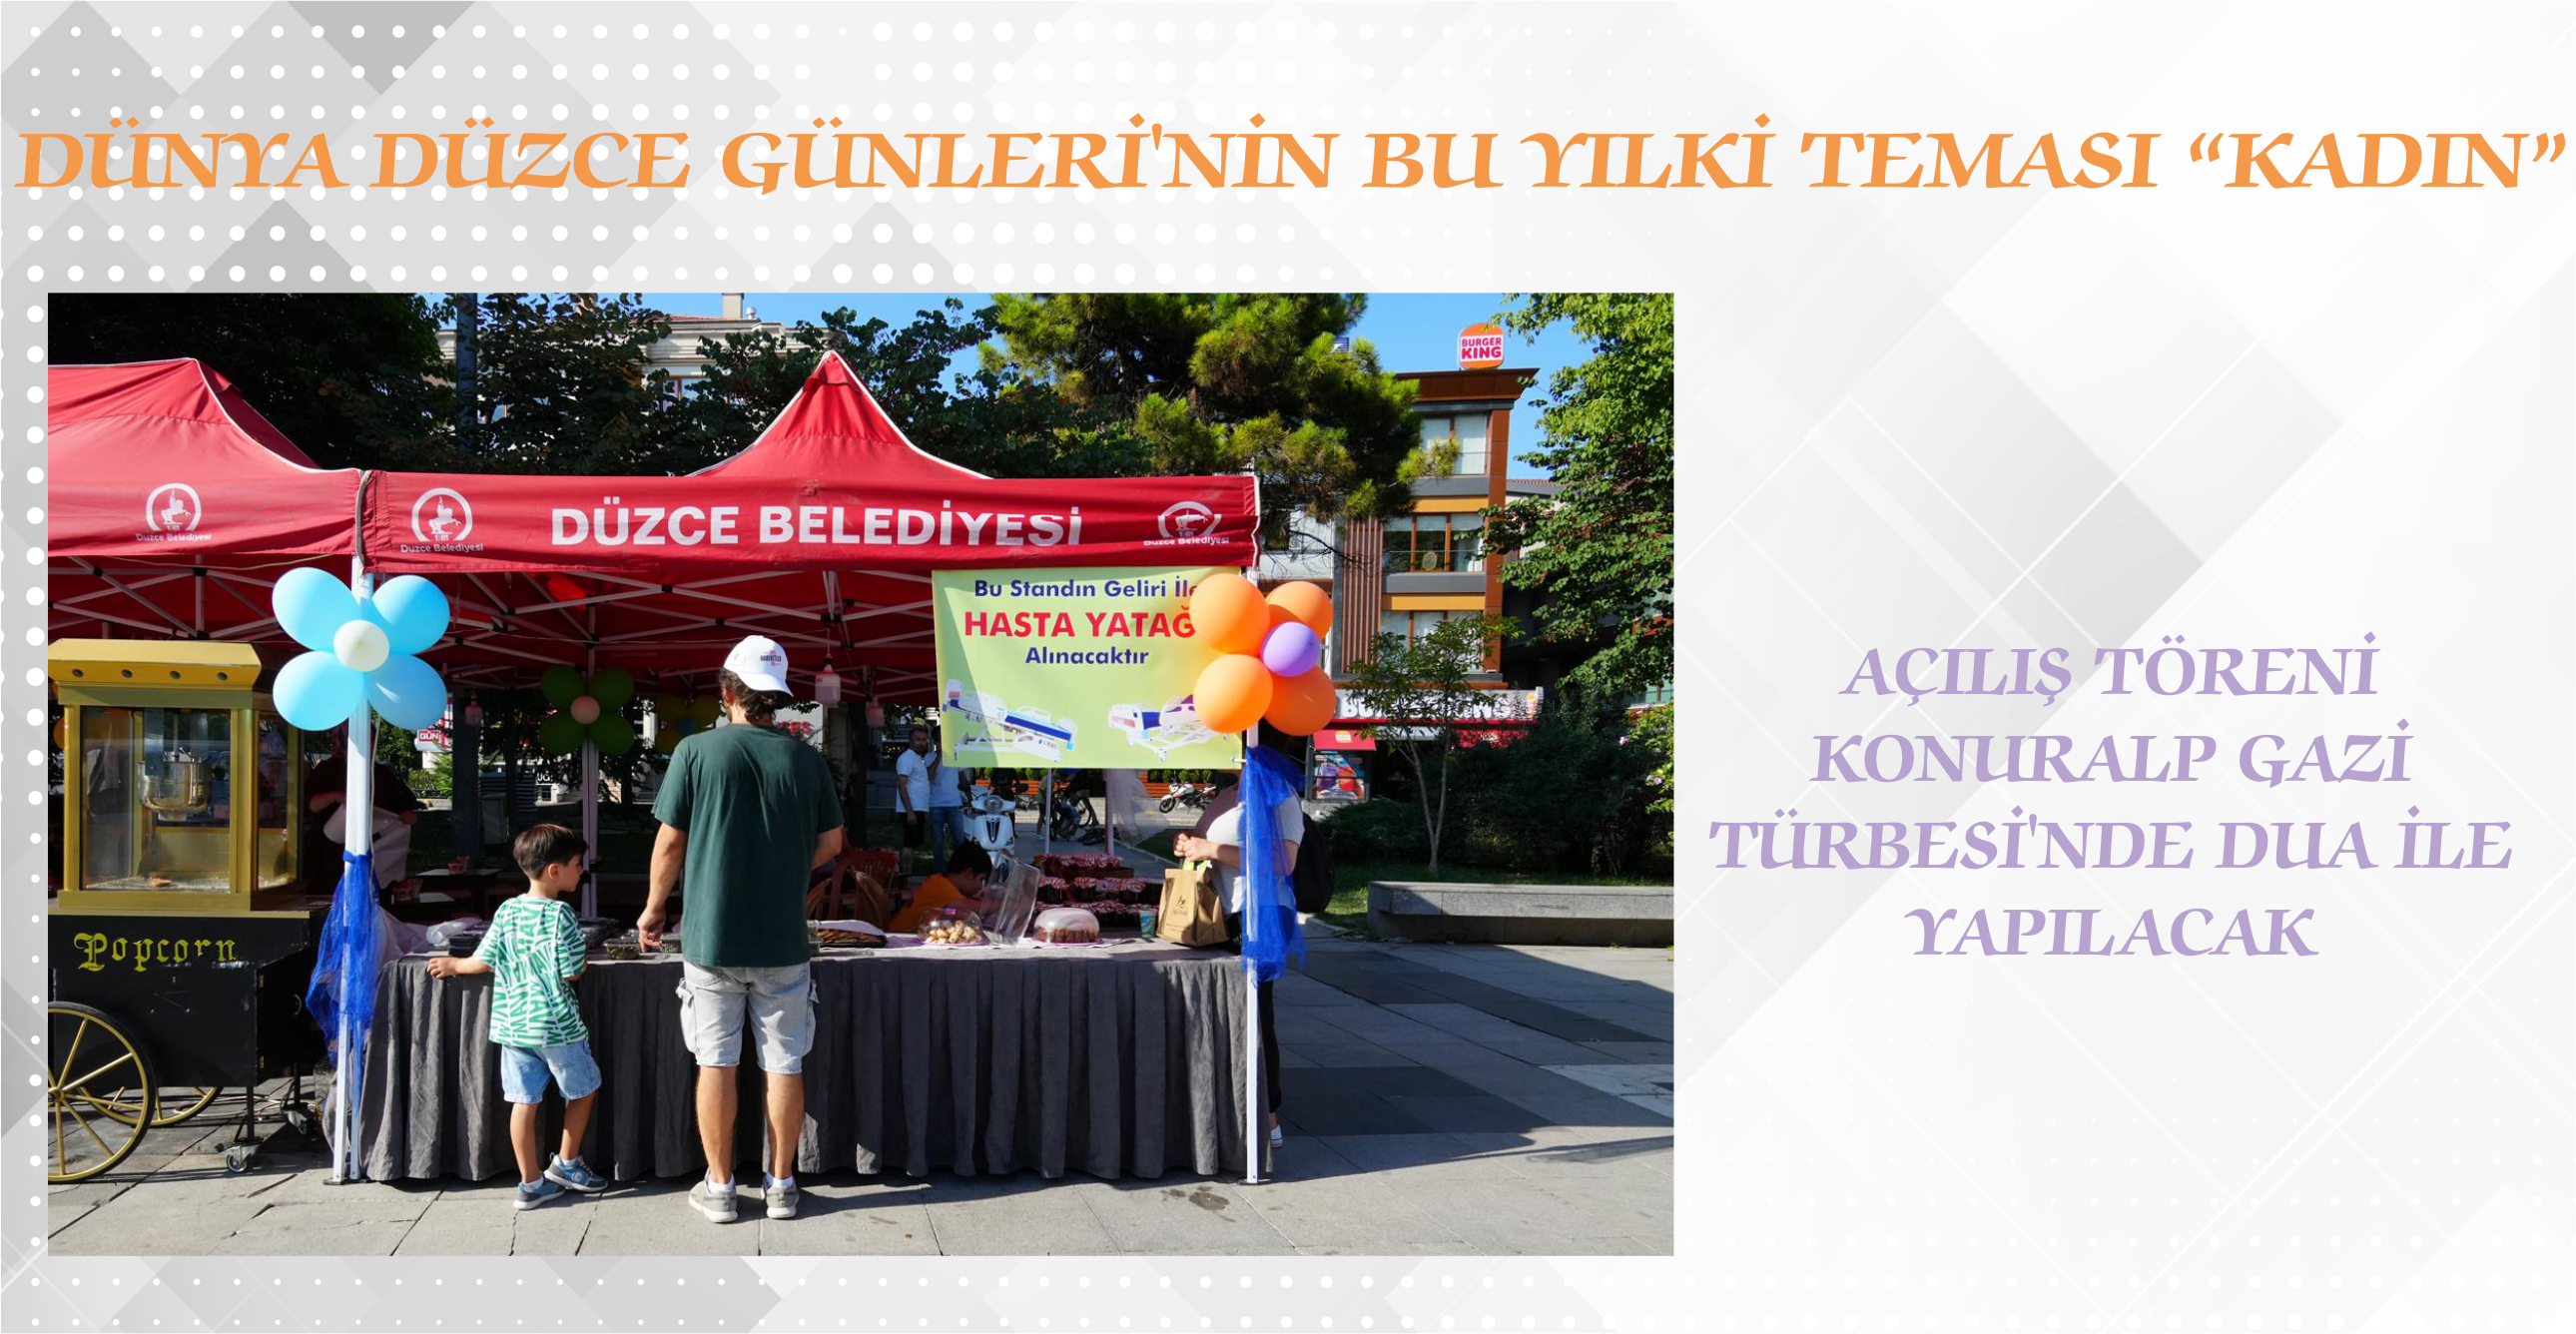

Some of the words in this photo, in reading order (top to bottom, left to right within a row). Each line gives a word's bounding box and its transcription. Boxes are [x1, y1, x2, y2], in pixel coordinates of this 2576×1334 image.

[1462, 336, 1502, 347] BURGER
[1461, 346, 1502, 359] KING
[551, 496, 740, 546] DÜZCE
[759, 499, 1082, 546] BELEDİYESİ
[974, 579, 1003, 597] Bu
[1010, 579, 1095, 597] Standın
[1104, 578, 1166, 597] Geliri
[965, 611, 1075, 637] HASTA
[1085, 604, 1196, 638] YATAĞ
[1025, 646, 1149, 665] Alınacaktır
[73, 932, 236, 973] Popcorn
